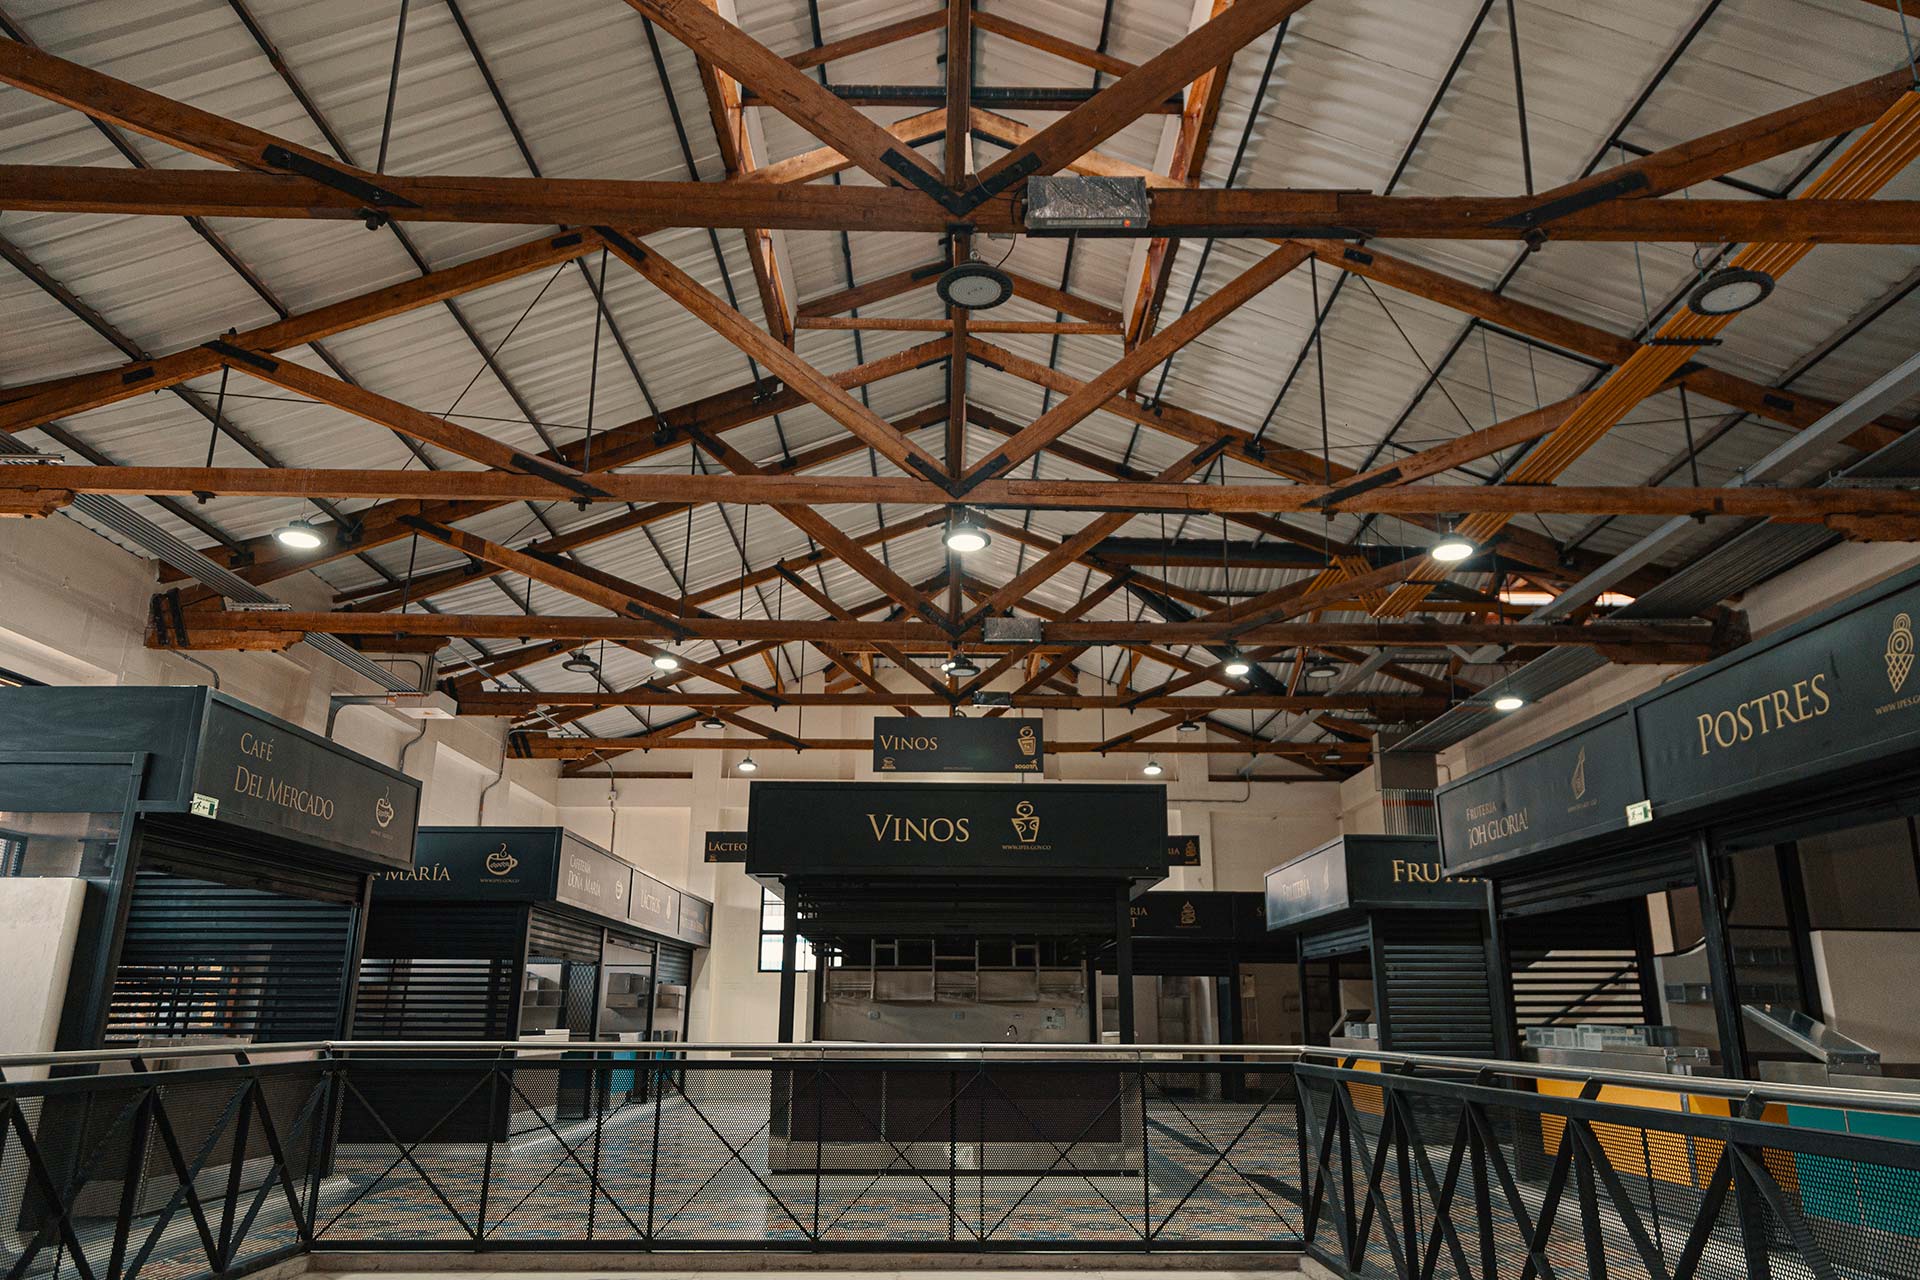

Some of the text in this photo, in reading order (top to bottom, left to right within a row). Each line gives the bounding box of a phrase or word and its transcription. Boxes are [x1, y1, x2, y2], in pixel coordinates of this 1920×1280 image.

[1697, 673, 1830, 756] POSTRES
[240, 732, 274, 761] CAFÉ
[880, 735, 938, 750] VINOS
[234, 765, 334, 820] DEL MERCADO
[866, 814, 970, 842] VINOS
[1488, 807, 1529, 841] GLORIA!
